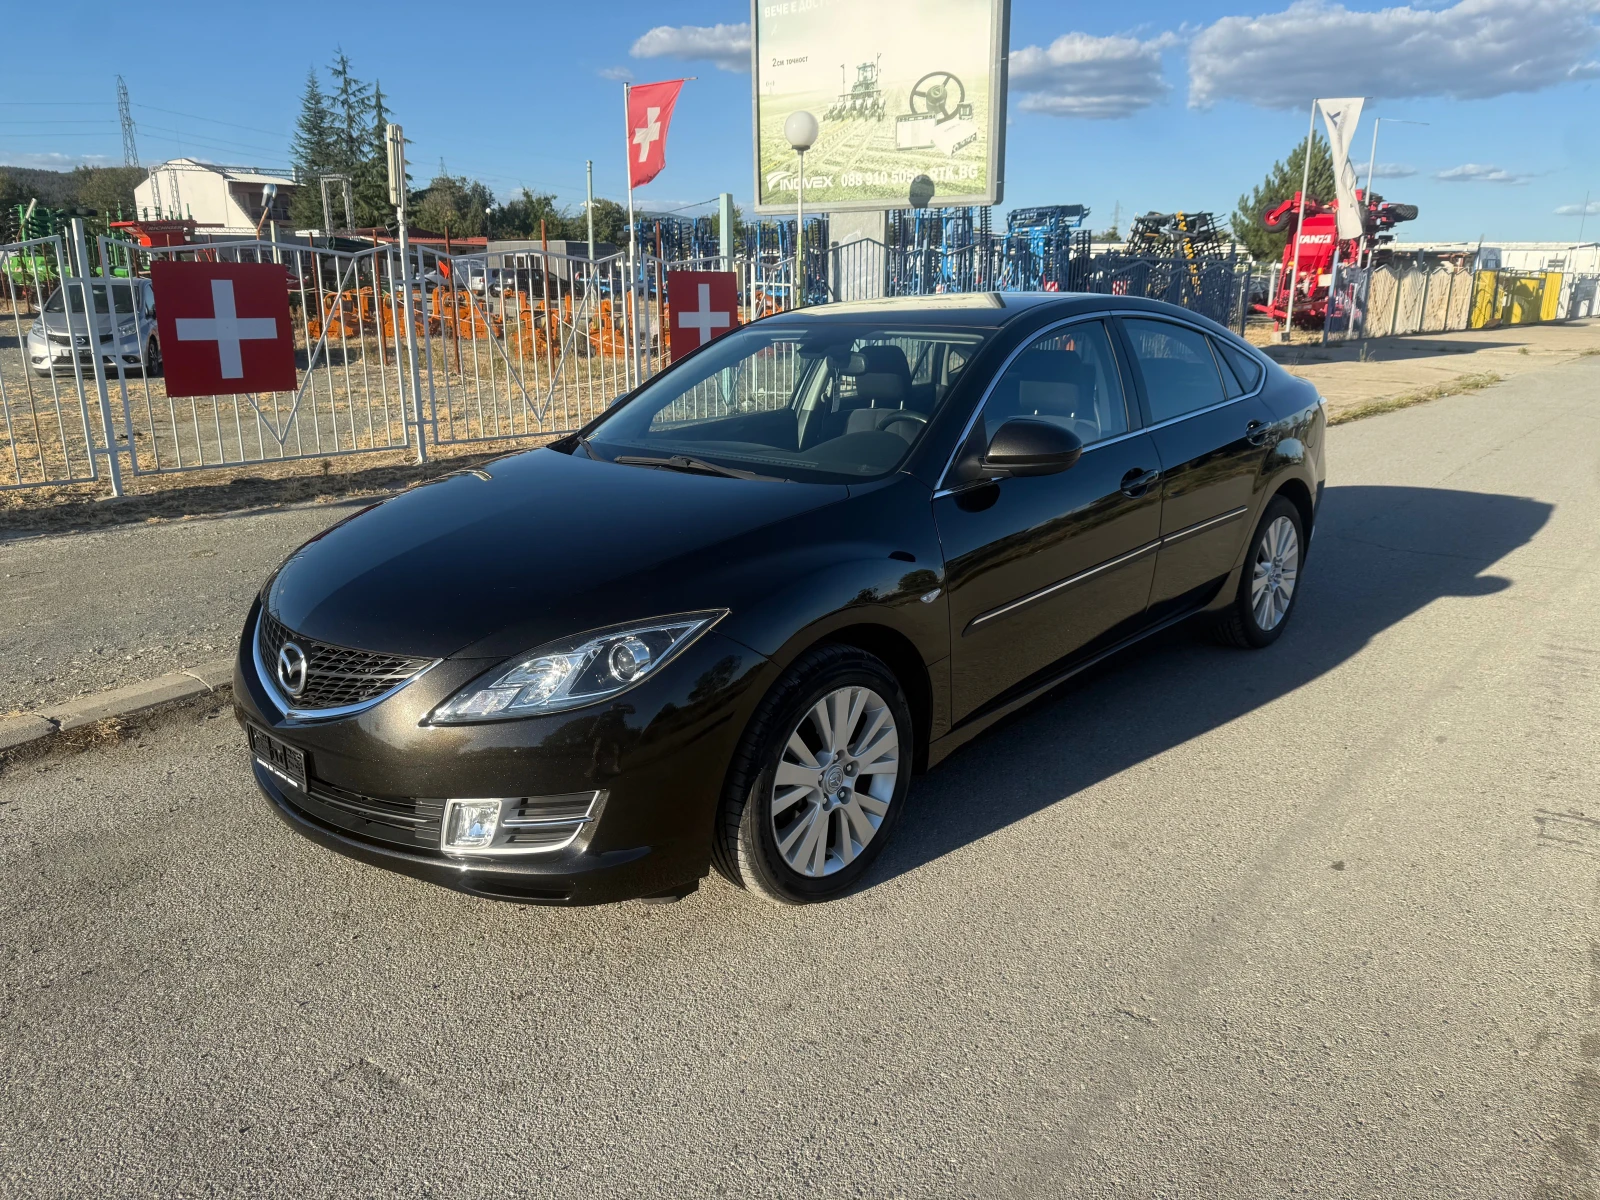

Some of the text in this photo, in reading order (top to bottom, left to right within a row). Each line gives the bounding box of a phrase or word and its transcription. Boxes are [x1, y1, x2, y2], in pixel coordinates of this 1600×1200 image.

[764, 3, 789, 18] ВЕЧЕ
[841, 172, 863, 187] 088
[865, 170, 887, 186] 910
